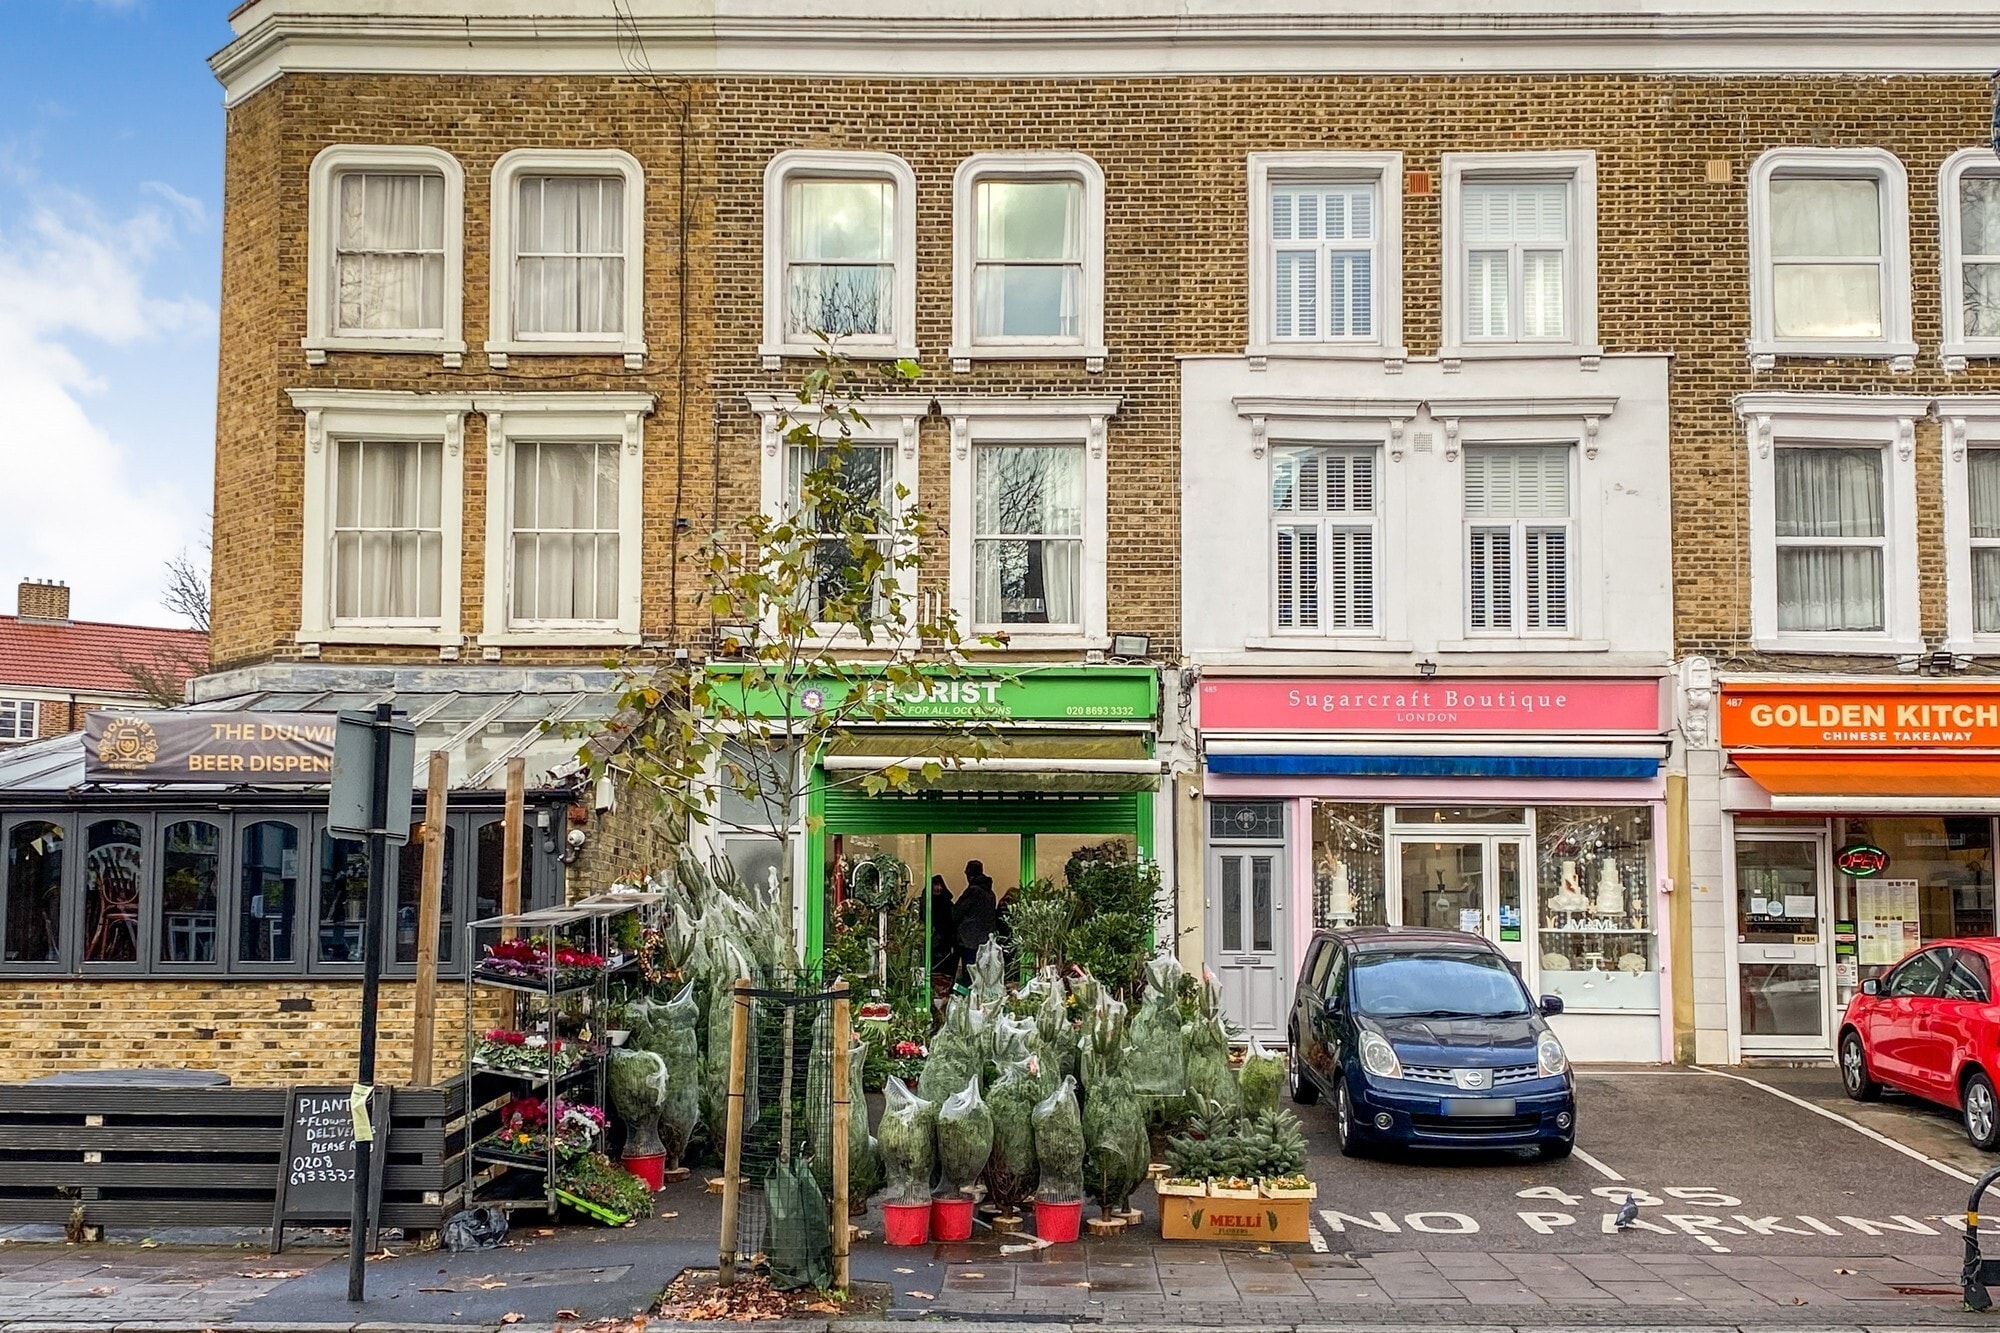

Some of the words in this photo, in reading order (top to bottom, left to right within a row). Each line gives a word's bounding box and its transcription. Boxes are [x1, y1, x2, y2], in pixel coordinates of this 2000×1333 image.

[867, 681, 1001, 703] FLORIST
[1288, 689, 1431, 712] Sugarcraft
[1445, 690, 1567, 713] Boutique
[1726, 698, 1743, 707] 487
[908, 706, 929, 715] FOR
[931, 706, 950, 715] ALL
[1066, 706, 1084, 716] 020
[1085, 706, 1109, 716] 8693
[1111, 706, 1134, 716] 3332
[1397, 712, 1458, 722] LONDON
[1750, 704, 1885, 727] GOLDEN
[1898, 704, 1999, 727] KITCH
[102, 716, 156, 739] SOUTHEY
[211, 724, 255, 741] THE
[1823, 731, 1888, 741] CHINESE
[1894, 731, 1973, 741] TAKEAWAY
[188, 755, 244, 771] BEER
[250, 755, 333, 772] DISPEN
[1237, 812, 1255, 822] 485
[1838, 852, 1885, 870] OPEN
[306, 1126, 376, 1141] DELIVES
[311, 1141, 346, 1154] PLEASE
[293, 1155, 333, 1172] 0208
[290, 1169, 355, 1186] 6933332
[1515, 1186, 1742, 1207] 485
[1319, 1211, 1481, 1234] NO
[1516, 1212, 2000, 1236] PARKING
